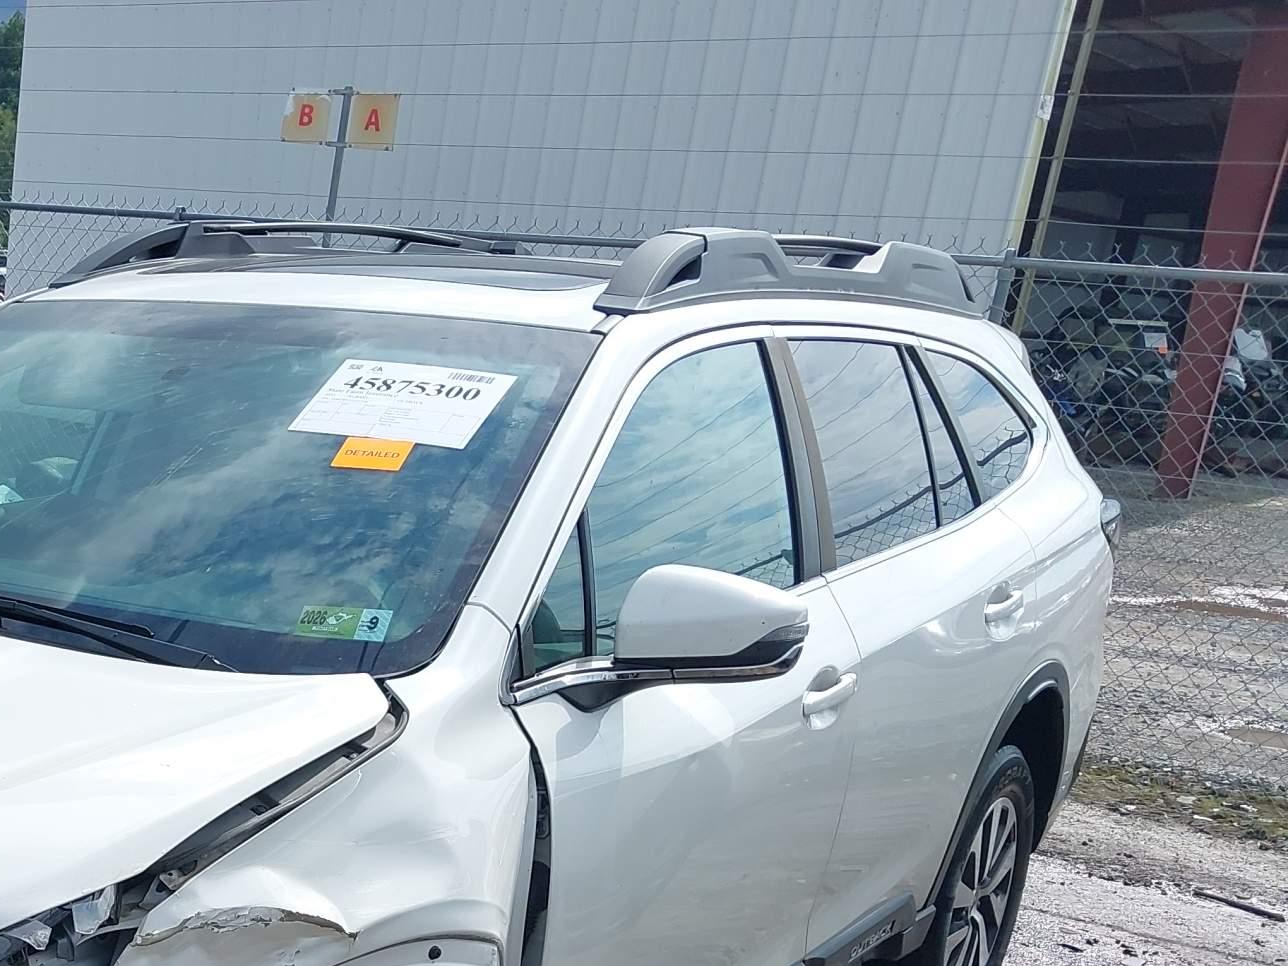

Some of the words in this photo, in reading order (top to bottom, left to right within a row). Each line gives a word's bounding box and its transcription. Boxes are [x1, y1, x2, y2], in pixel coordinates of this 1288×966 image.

[298, 103, 314, 126] B
[364, 108, 380, 132] A
[343, 375, 481, 401] 45875300
[344, 448, 400, 459] DETAILED
[300, 610, 327, 625] 2026
[368, 615, 380, 630] 9
